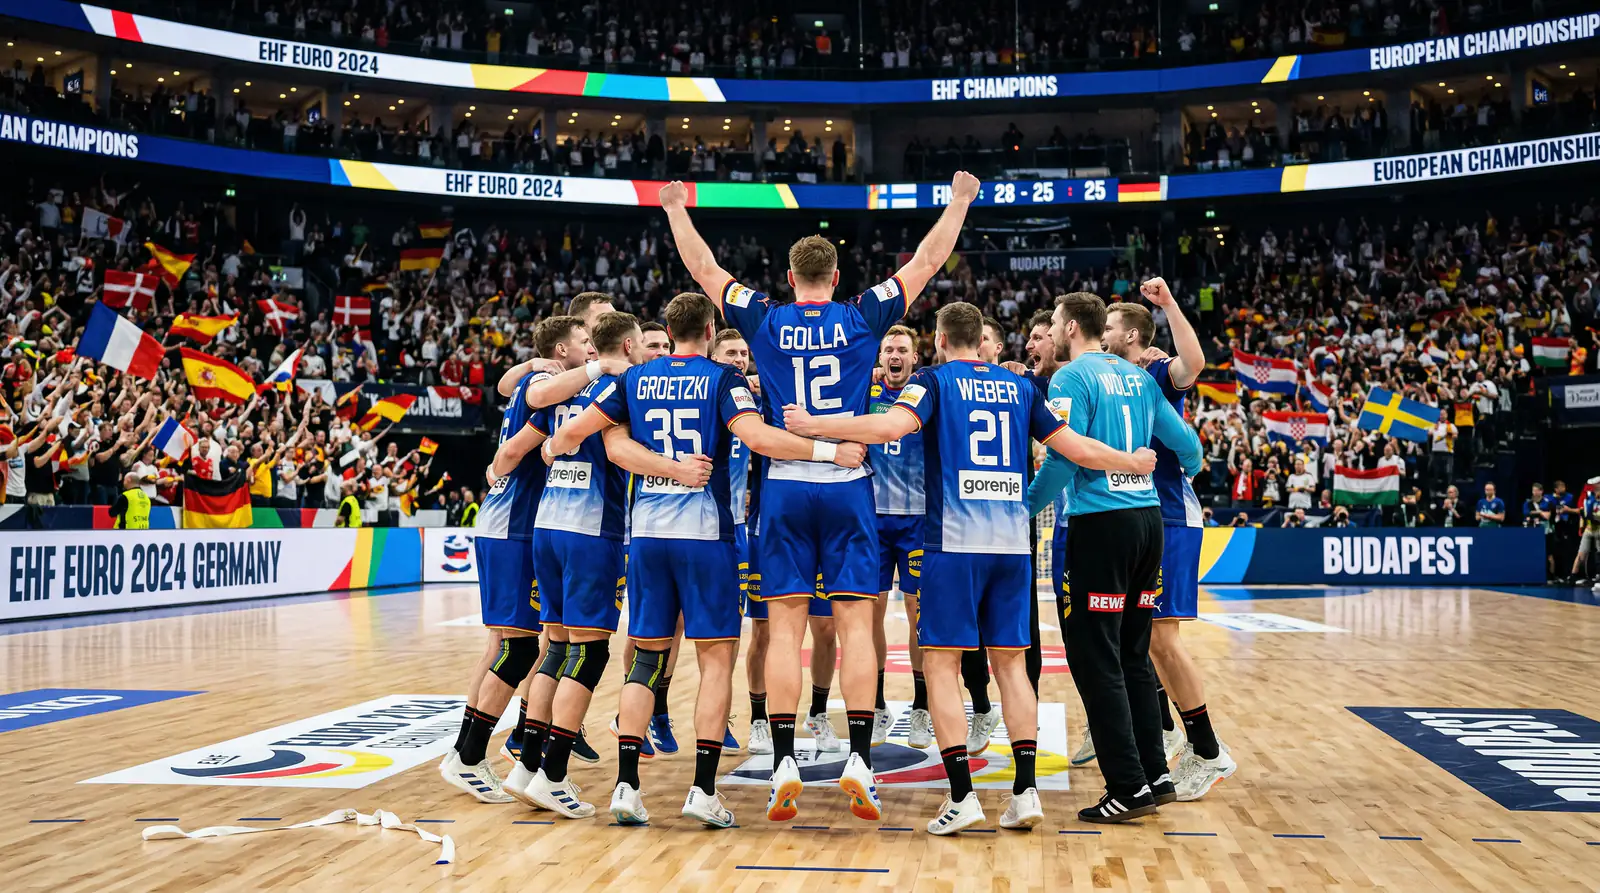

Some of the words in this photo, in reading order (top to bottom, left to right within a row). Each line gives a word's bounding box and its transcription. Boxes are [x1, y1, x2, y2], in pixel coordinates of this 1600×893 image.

[1370, 36, 1460, 71] EUROPEAN
[1463, 13, 1600, 57] CHAMPIONSHIP
[259, 40, 288, 62] EHF
[292, 44, 333, 69] EURO
[338, 51, 379, 74] 2024
[931, 79, 960, 101] EHF
[963, 75, 1058, 99] CHAMPIONS
[0, 113, 28, 142] AN
[31, 119, 139, 158] CHAMPIONS
[1374, 152, 1463, 182] EUROPEAN
[445, 173, 473, 193] EHF
[478, 175, 517, 196] EURO
[522, 178, 563, 198] 2024
[994, 183, 1016, 203] 28
[1032, 181, 1054, 203] 25
[1084, 179, 1106, 201] 25
[1010, 255, 1066, 271] BUDAPEST
[779, 323, 848, 350] GOLLA
[636, 375, 710, 400] GROETZKI
[791, 355, 843, 410] 12
[956, 378, 1020, 405] WEBER
[1098, 373, 1143, 397] WOLFF
[644, 408, 703, 461] 35
[969, 409, 1011, 467] 21
[1121, 404, 1133, 455] 1
[646, 474, 693, 488] gore
[963, 477, 1020, 496] gorenje
[1323, 535, 1474, 576] BUDAPEST
[9, 545, 57, 603] EHF
[63, 543, 125, 599] EURO
[131, 542, 187, 594] 2024
[192, 540, 282, 589] GERMANY
[1089, 595, 1125, 609] REWE
[1139, 593, 1156, 606] RE
[267, 721, 412, 748] EURO
[356, 699, 468, 719] 2024
[1403, 711, 1600, 802] UDAPEST
